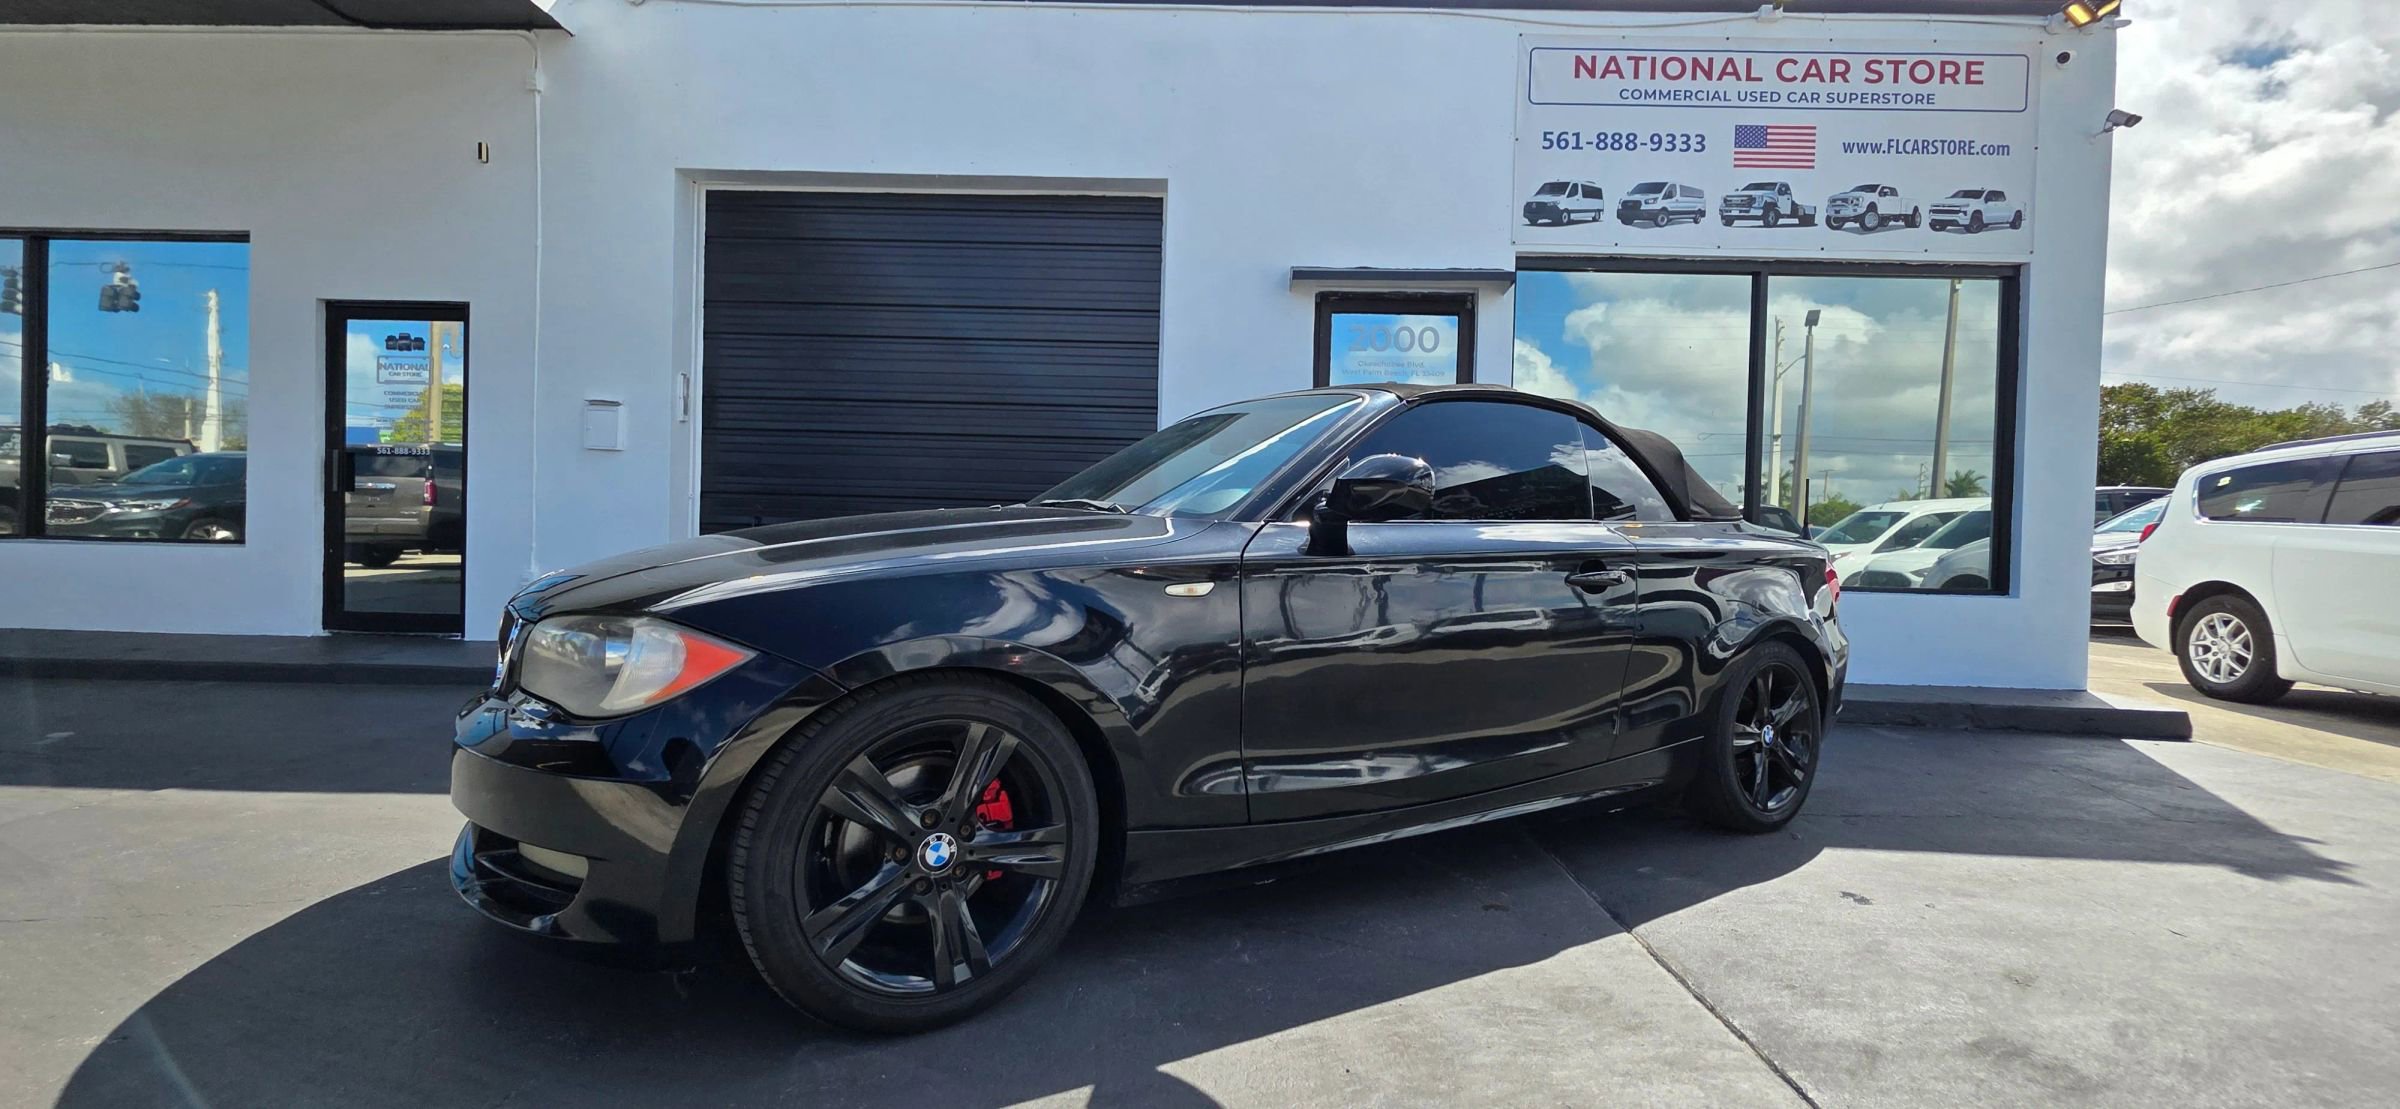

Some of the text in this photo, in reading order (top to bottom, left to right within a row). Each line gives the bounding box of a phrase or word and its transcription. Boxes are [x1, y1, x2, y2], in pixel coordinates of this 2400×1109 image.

[1573, 54, 1985, 85] NATIONAL CAR STORE
[1619, 88, 1936, 105] COMMERCIAL USED CAR SUPERSTORE
[1541, 131, 1707, 153] 561-888-9333
[1842, 138, 2011, 157] www.FLCARSTORE.com
[1348, 324, 1440, 353] 2000
[379, 362, 430, 371] NATIONAL
[1363, 368, 1383, 376] Palm
[377, 447, 431, 456] 561-888-9333
